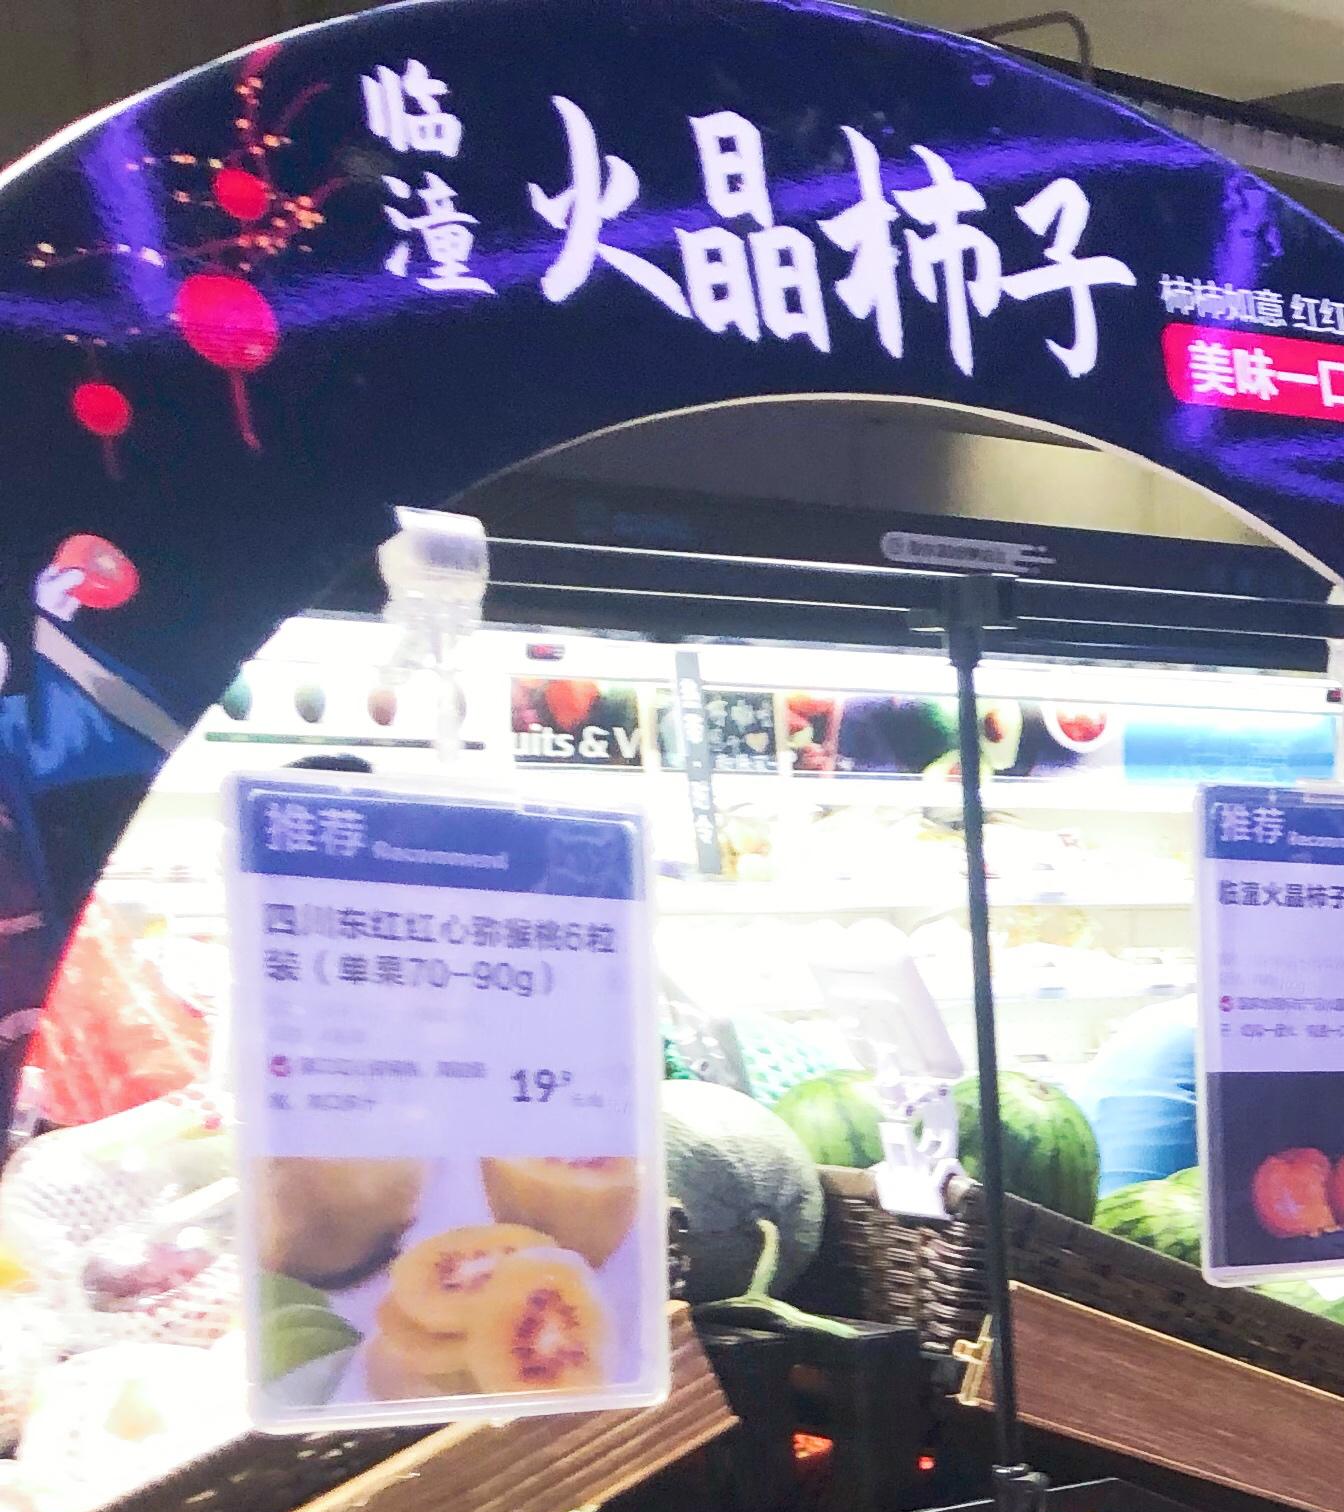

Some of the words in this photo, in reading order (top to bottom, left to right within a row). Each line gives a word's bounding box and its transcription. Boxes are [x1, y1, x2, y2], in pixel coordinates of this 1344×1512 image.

[360, 58, 496, 295] 临潼
[527, 94, 1137, 379] 火晶柿子
[512, 723, 575, 760] uits
[580, 727, 609, 760] &
[611, 727, 641, 761] V
[264, 801, 369, 858] 推荐
[1213, 801, 1286, 844] 推荐
